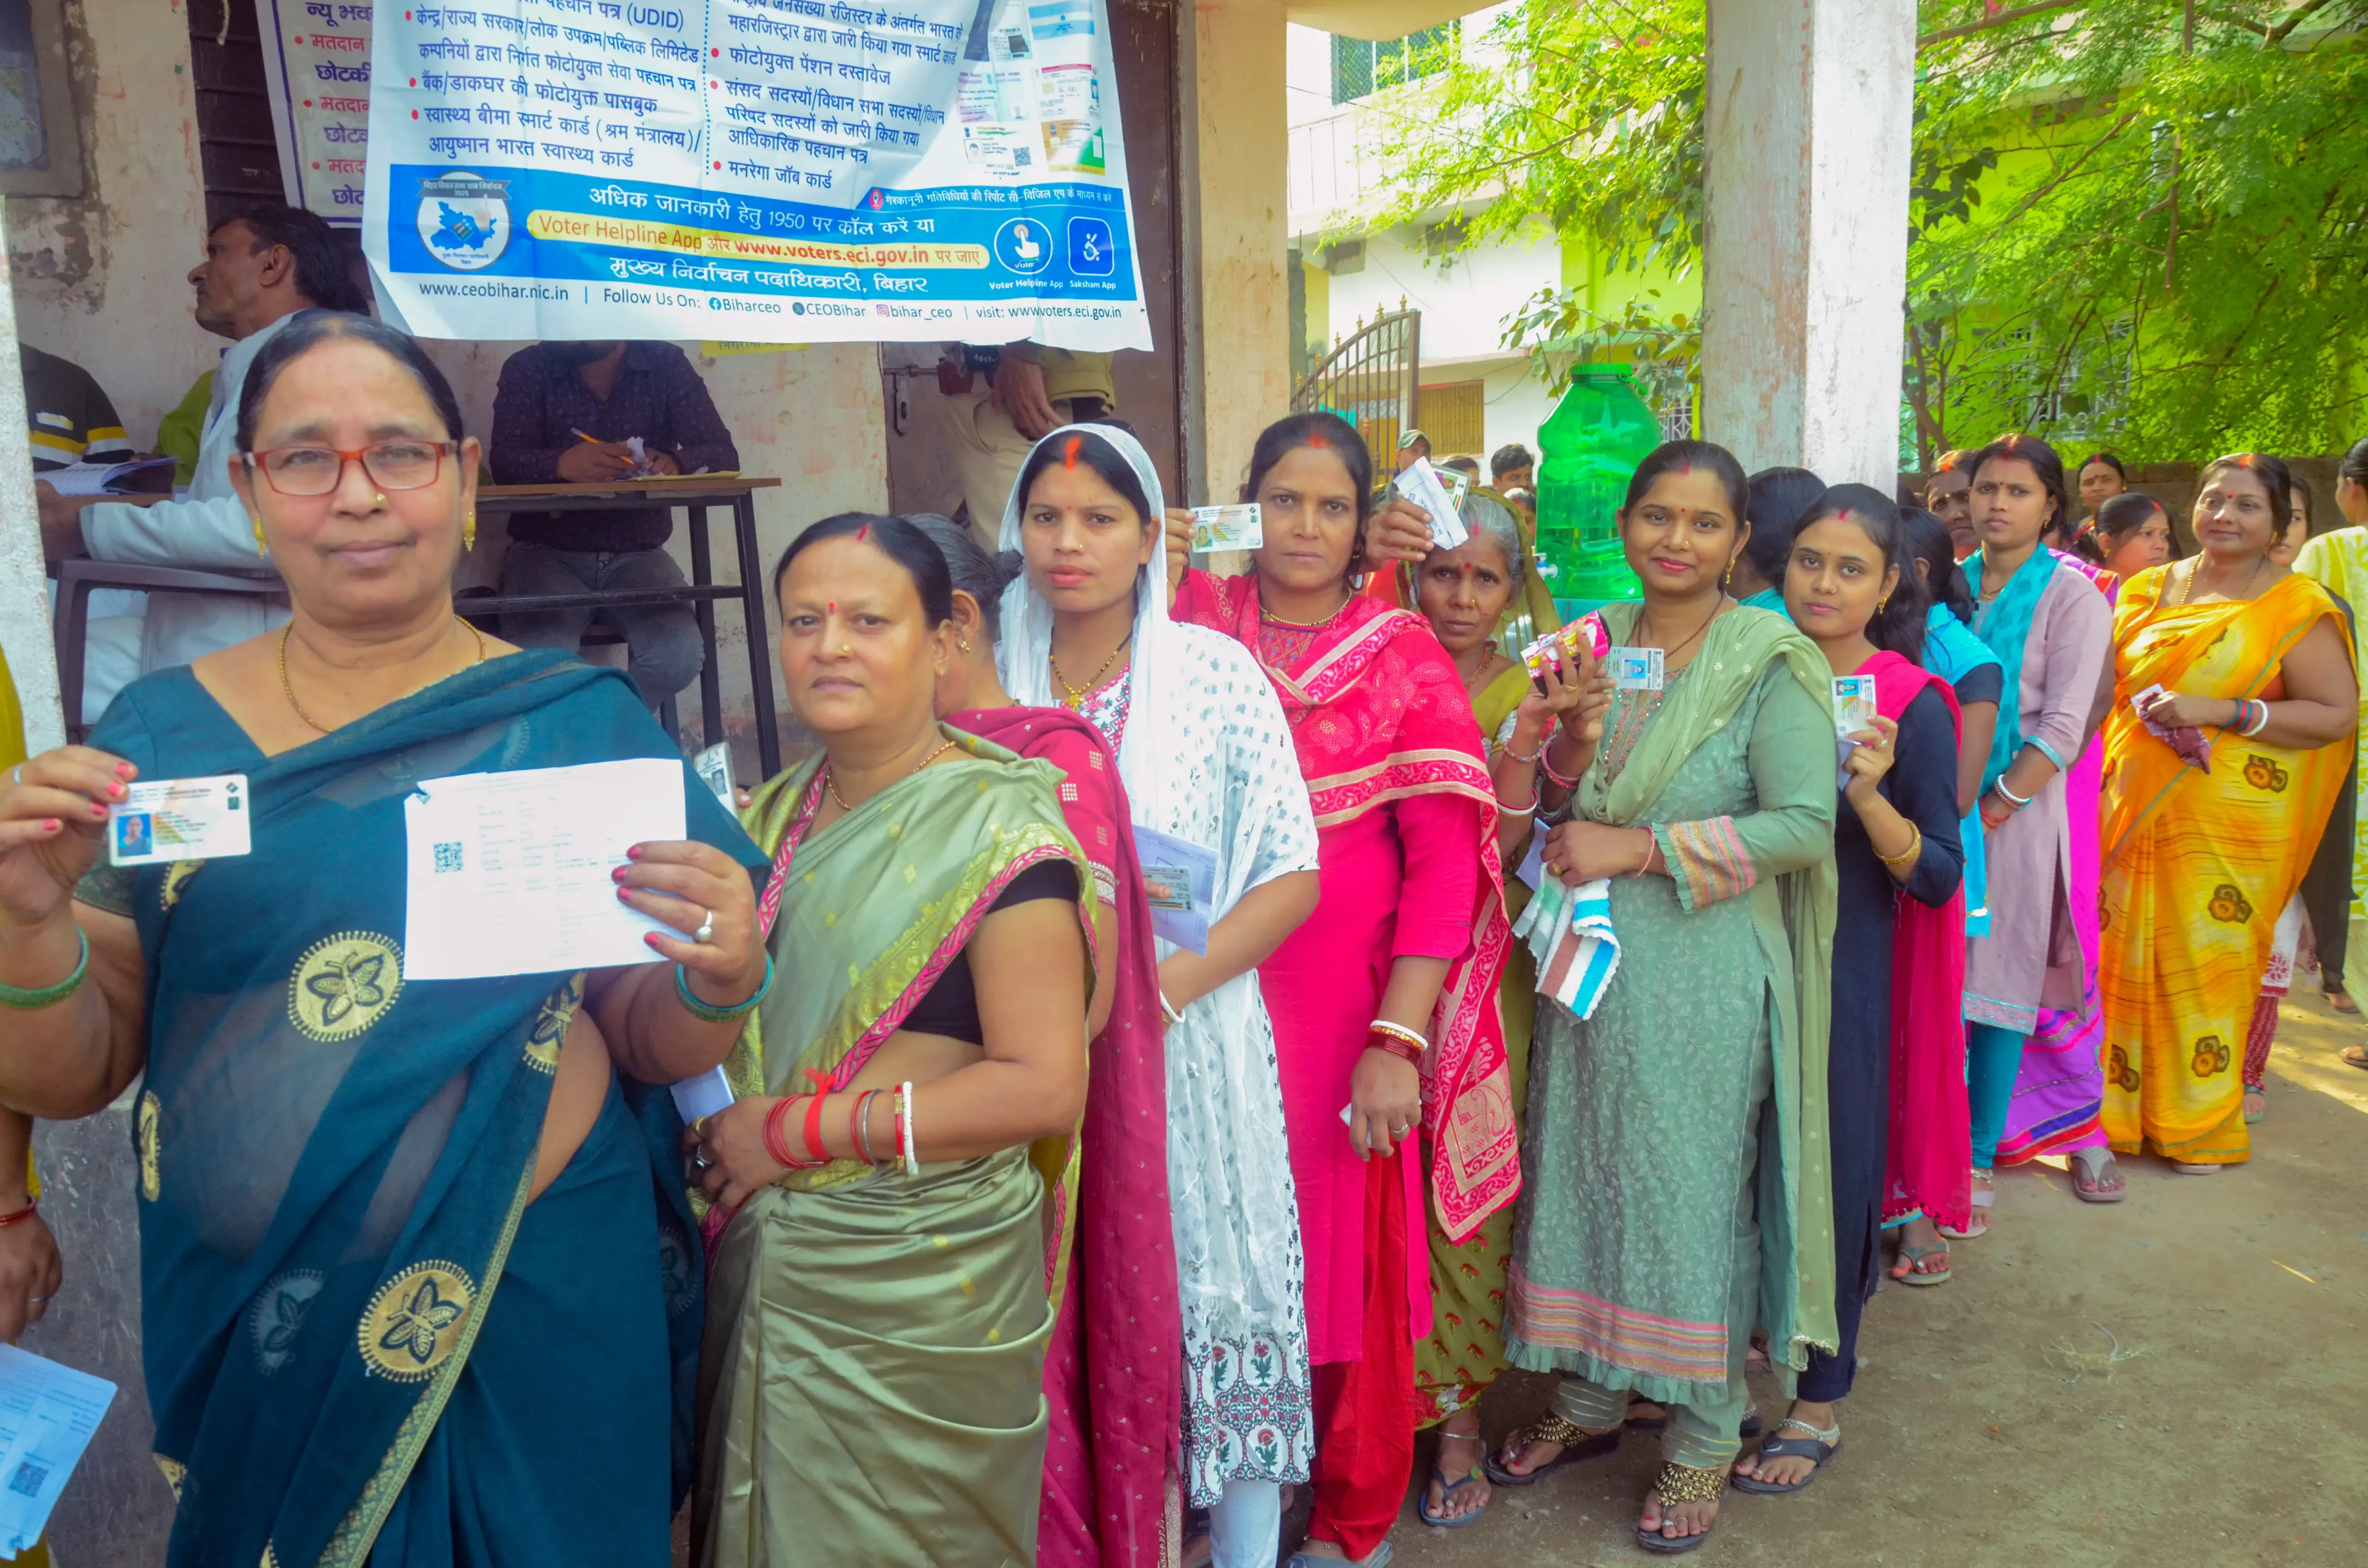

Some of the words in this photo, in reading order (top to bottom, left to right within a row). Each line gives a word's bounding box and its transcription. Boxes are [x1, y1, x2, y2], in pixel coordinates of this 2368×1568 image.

[306, 2, 340, 27] न्यू
[339, 5, 372, 21] भव
[598, 2, 621, 20] पत्र
[627, 2, 683, 33] (UDID)
[829, 1, 873, 25] रजिस्टर
[876, 8, 887, 27] के
[890, 12, 925, 35] अंतर्गत
[929, 22, 954, 40] भारत
[310, 34, 365, 52] मतदान
[650, 37, 699, 63] लिमिटेड
[728, 13, 800, 41] महारजिस्ट्रार
[803, 26, 827, 44] द्वारा
[831, 28, 857, 48] जारी
[861, 31, 888, 53] किया
[891, 41, 912, 58] गया
[915, 43, 941, 63] स्मार्ट
[943, 47, 958, 65] कार्ड
[419, 37, 469, 60] कम्पनियों
[474, 45, 502, 62] द्वारा
[506, 43, 540, 68] निर्गत
[544, 50, 602, 81] फोटोयुक्त
[607, 59, 631, 80] सेवा
[635, 68, 674, 88] पहचान
[678, 77, 696, 92] पत्र
[729, 43, 794, 74] फोटोयुक्त
[799, 52, 833, 76] पेंशन
[838, 63, 891, 85] दस्तावेज
[422, 69, 505, 96] बैंक/डाकघर
[510, 75, 529, 97] की
[535, 79, 599, 110] फोटोयुक्त
[604, 93, 657, 117] पासबुक
[725, 77, 762, 99] संसद
[859, 98, 884, 116] सभा
[424, 108, 470, 123] स्वास्थ्य
[476, 102, 510, 125] बीमा
[517, 110, 553, 130] स्मार्ट
[558, 115, 590, 135] कार्ड
[725, 103, 766, 125] परिषद
[771, 112, 816, 132] सदस्यों
[821, 115, 838, 135] को
[842, 120, 871, 139] जारी
[875, 122, 899, 144] किया
[902, 130, 920, 147] गया
[429, 137, 490, 159] आयुष्मान
[496, 138, 534, 157] भारत
[541, 142, 594, 164] स्वास्थ्य
[599, 147, 634, 167] कार्ड
[728, 126, 800, 153] आधिकारिक
[804, 140, 845, 160] पहचान
[850, 148, 868, 164] पत्र
[327, 159, 366, 174] मतद
[728, 159, 770, 181] मनरेगा
[774, 165, 801, 185] जॉब
[804, 170, 832, 189] कार्ड
[589, 184, 648, 208] अधिक
[654, 195, 731, 219] जानकारी
[738, 201, 762, 230] हेतु
[769, 211, 804, 229] 1950
[812, 216, 833, 233] पर
[839, 217, 874, 235] कॉल
[880, 217, 910, 234] करें
[914, 218, 935, 233] या
[971, 189, 982, 202] की
[1054, 189, 1065, 200] एप
[1067, 186, 1074, 198] के
[539, 215, 590, 236] Voter
[596, 221, 667, 245] Helpline
[672, 229, 702, 250] App
[707, 233, 730, 251] और
[735, 240, 929, 267] www.voters.eci.gov.in
[935, 249, 951, 263] पर
[955, 246, 980, 265] जाएं
[610, 257, 667, 278] मुख्य
[672, 259, 750, 284] निर्वाचन
[754, 268, 867, 293] पदाधिकारी,
[873, 272, 929, 293] बिहार
[989, 282, 1013, 290] Voter
[1050, 280, 1063, 289] App
[1070, 280, 1100, 289] Saksham
[1102, 281, 1116, 290] App
[419, 282, 569, 301] www.ceobihar.nic.in
[604, 288, 651, 305] Follow
[656, 292, 673, 306] Us
[677, 294, 701, 308] On:
[723, 298, 781, 314] Biharceo
[807, 303, 865, 317] CEOBihar
[976, 306, 1005, 318] visit:
